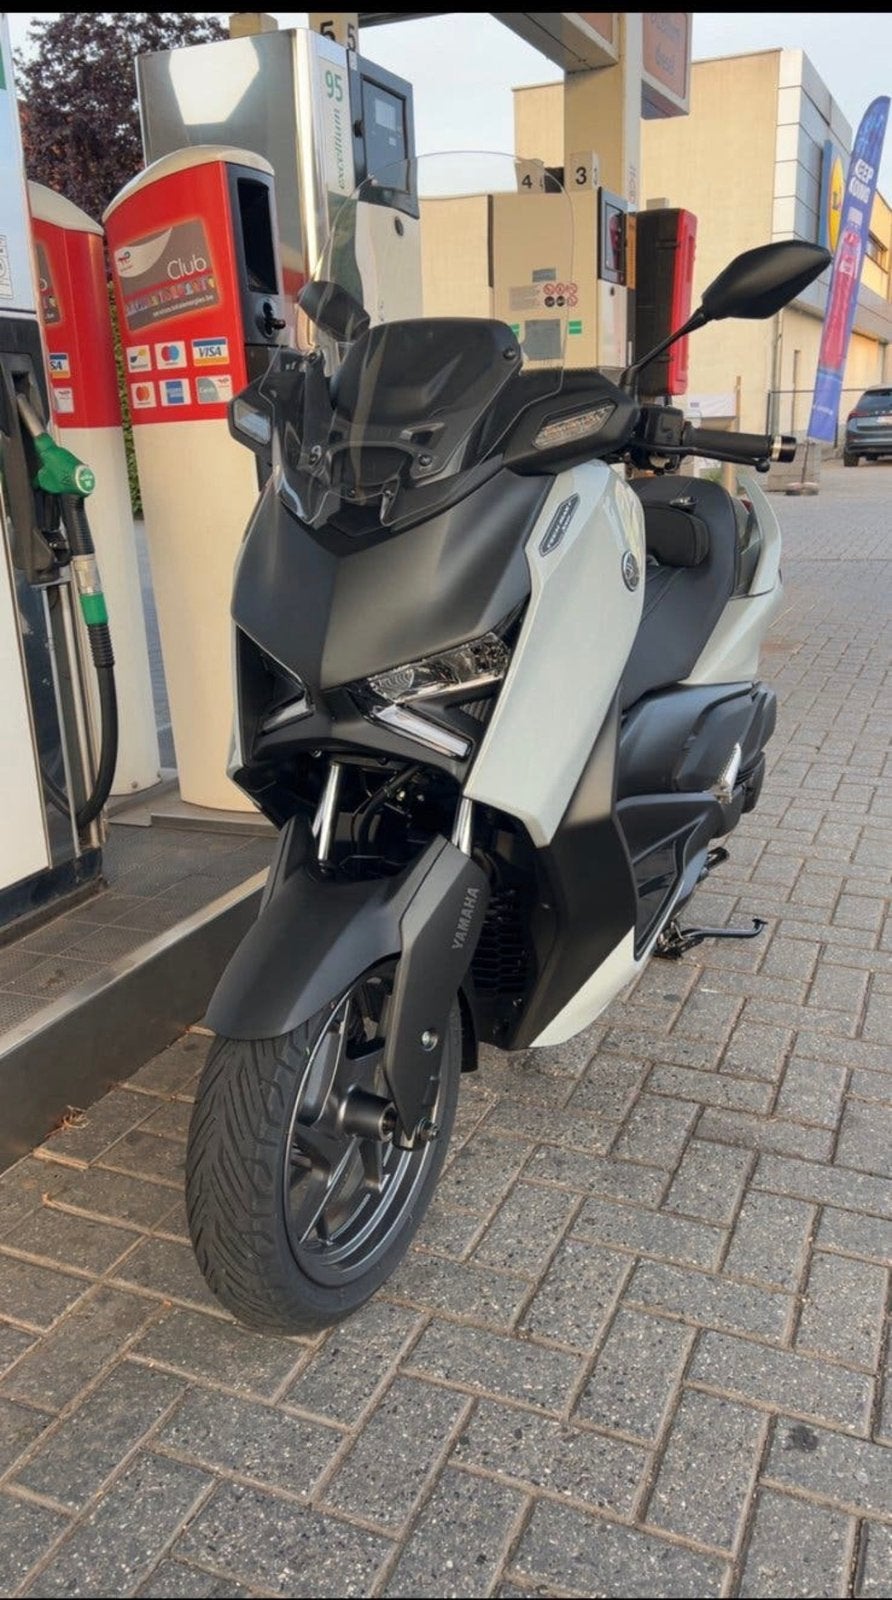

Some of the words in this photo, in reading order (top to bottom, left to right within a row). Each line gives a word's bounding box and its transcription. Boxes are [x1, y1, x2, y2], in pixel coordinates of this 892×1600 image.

[320, 20, 336, 42] 5
[325, 70, 343, 102] 95
[522, 174, 532, 189] 4
[575, 166, 587, 185] 3
[167, 254, 206, 280] Club
[199, 346, 222, 358] VISA
[50, 361, 63, 371] SA
[451, 887, 480, 949] YAMAHA
